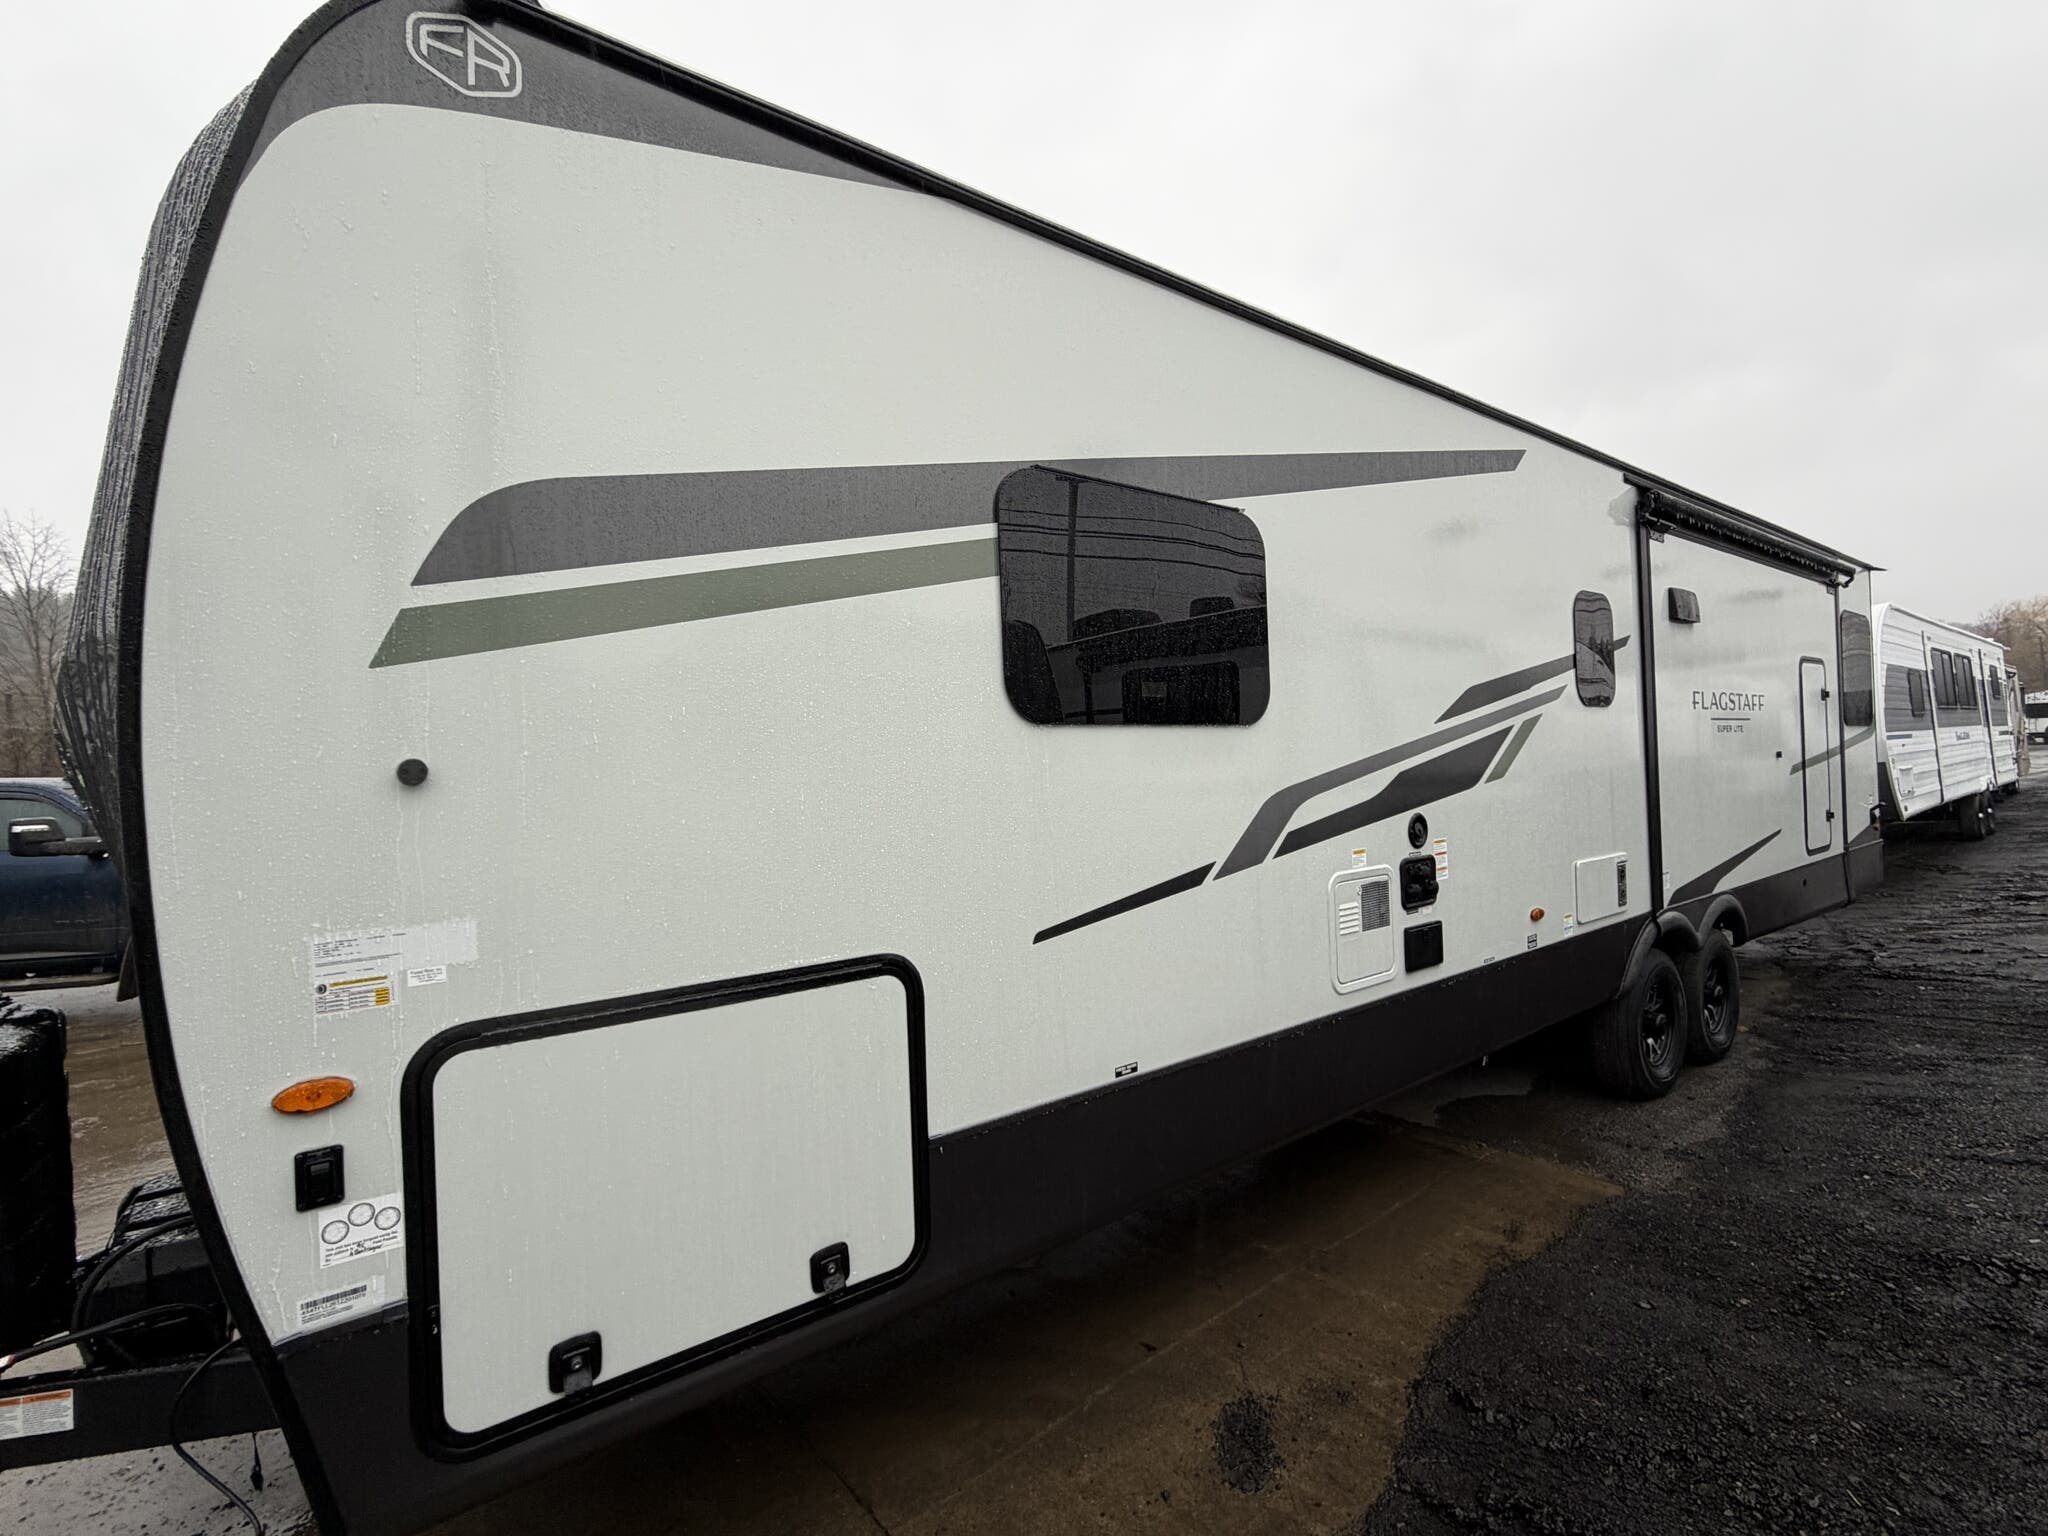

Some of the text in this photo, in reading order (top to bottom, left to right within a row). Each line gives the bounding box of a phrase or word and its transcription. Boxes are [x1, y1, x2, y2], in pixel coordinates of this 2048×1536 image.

[1692, 691, 1765, 711] FLAGSTAFF
[1717, 724, 1744, 733] SUPER LITE
